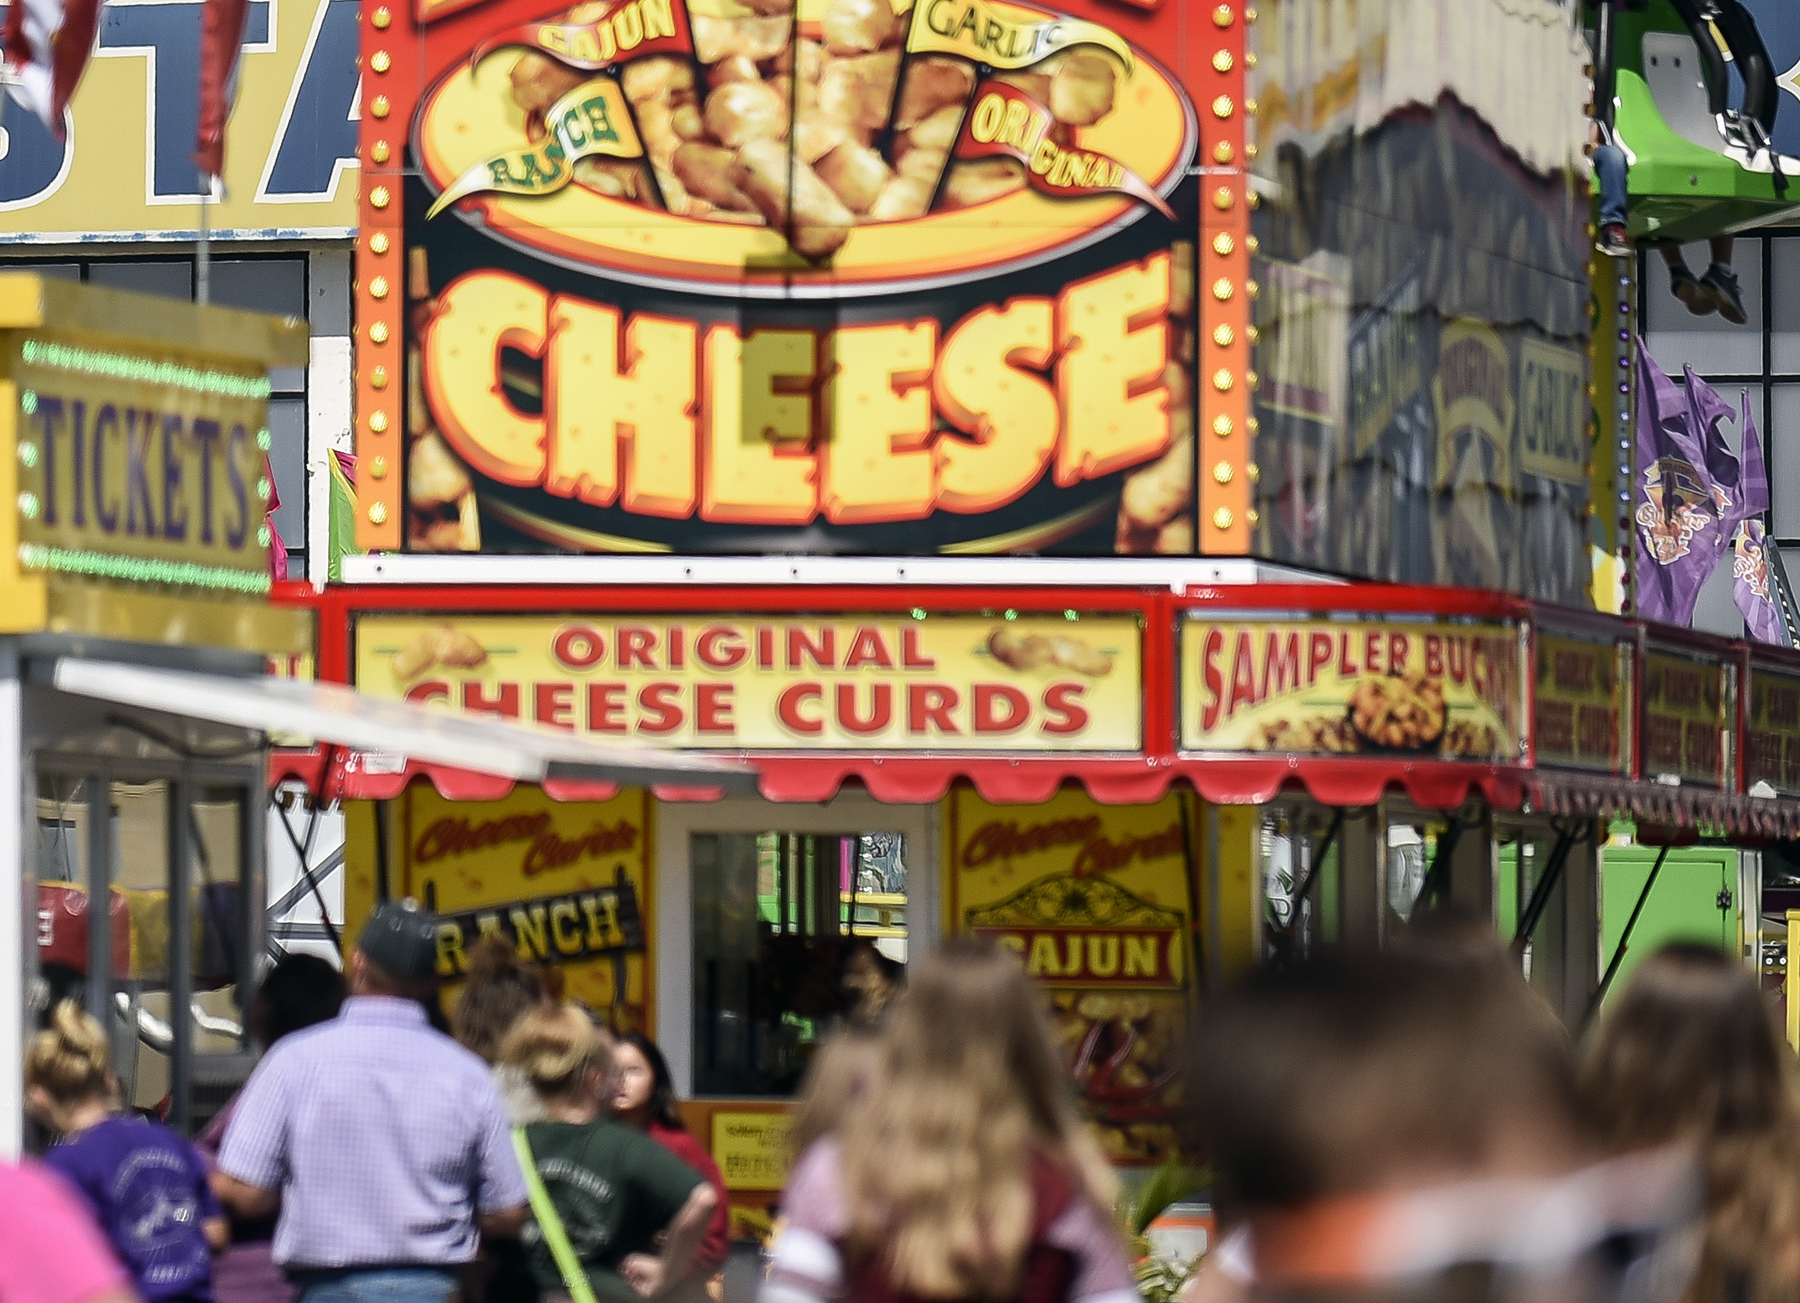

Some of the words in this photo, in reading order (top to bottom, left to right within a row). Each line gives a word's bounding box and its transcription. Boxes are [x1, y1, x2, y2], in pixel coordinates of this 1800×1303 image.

[487, 95, 618, 187] RANCH
[970, 93, 1127, 187] ORIGINAL
[423, 251, 1174, 523] CHEESE
[31, 395, 248, 549] TICKETS
[550, 624, 937, 671] ORIGINAL
[1199, 627, 1411, 732] SAMPLER
[777, 681, 1090, 735] CURDS
